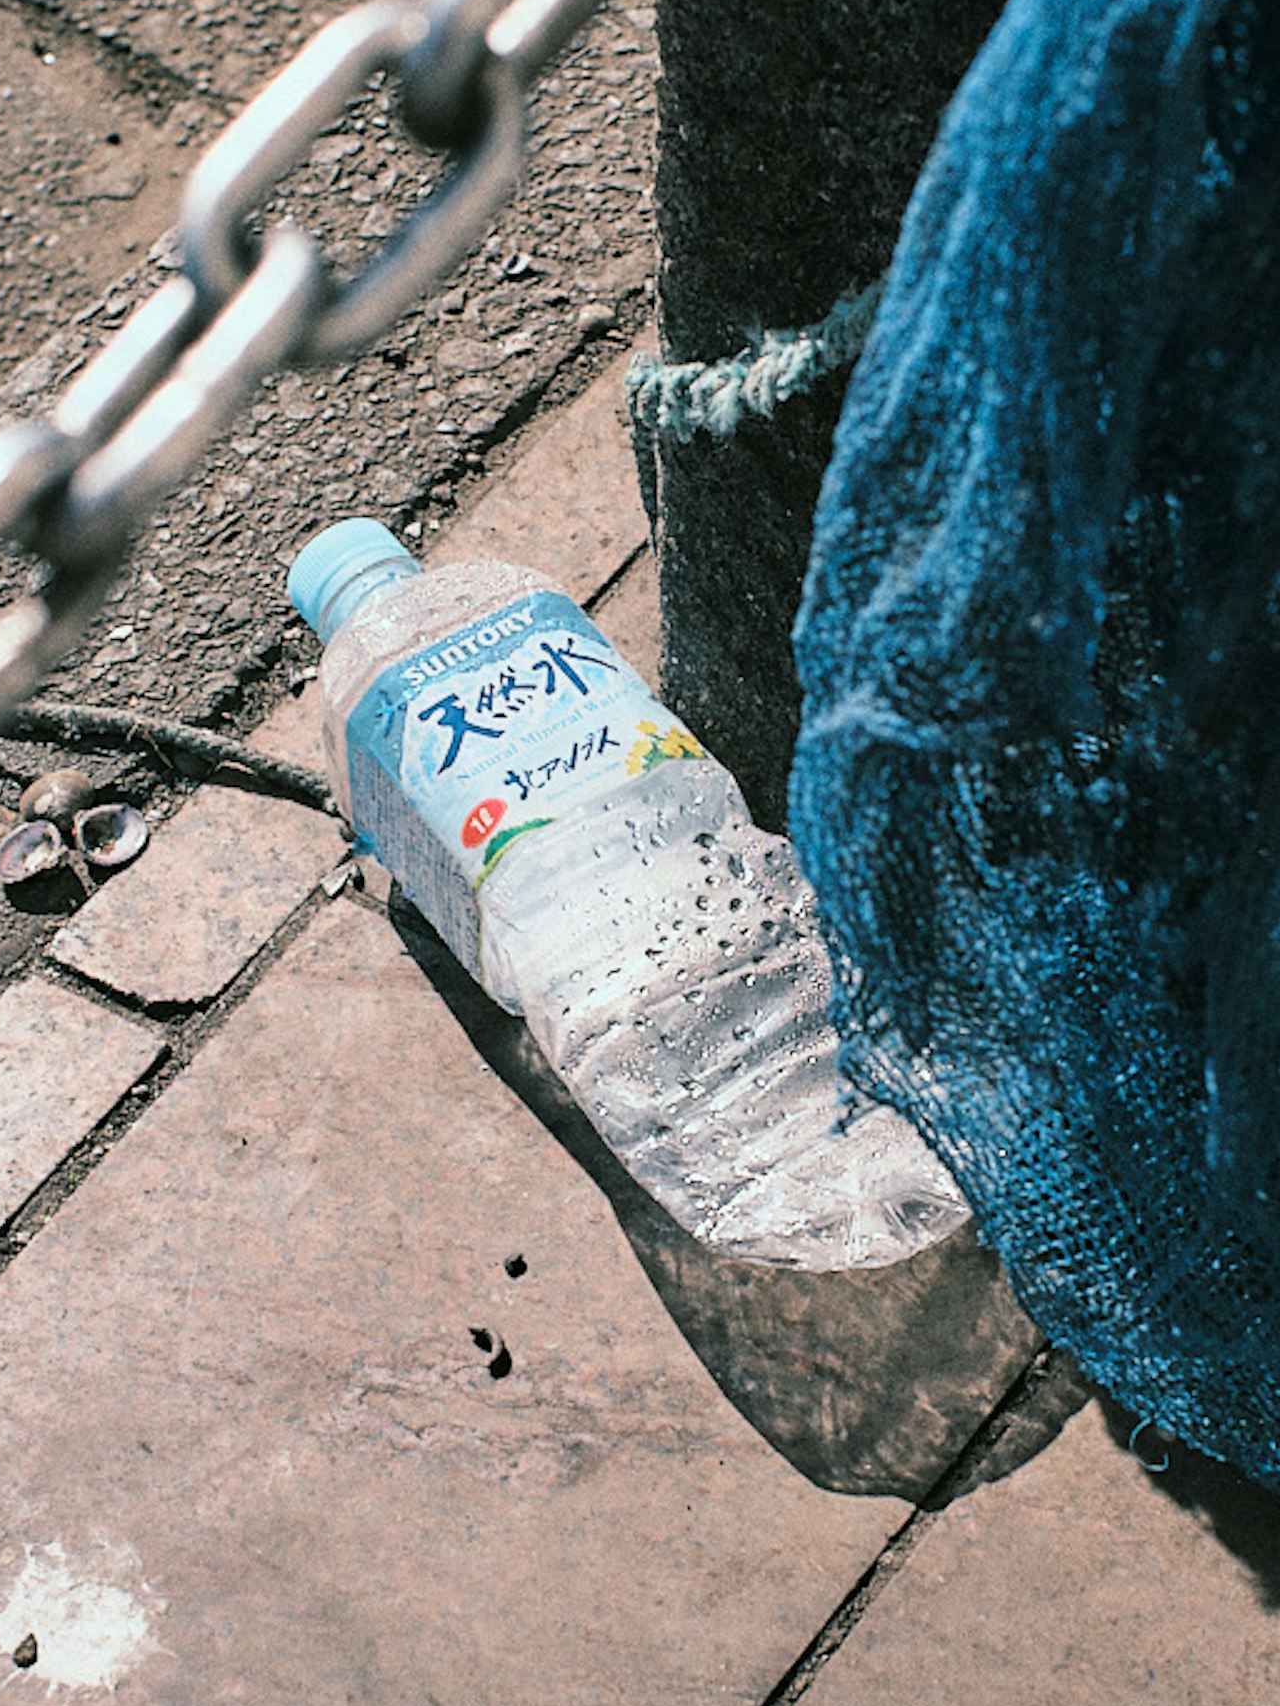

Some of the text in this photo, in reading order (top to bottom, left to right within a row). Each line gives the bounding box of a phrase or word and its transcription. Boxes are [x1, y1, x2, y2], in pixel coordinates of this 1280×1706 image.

[402, 607, 536, 687] SUNTORY
[417, 637, 619, 776] 天然水
[456, 743, 519, 779] Natural
[519, 707, 584, 745] Mineral
[503, 724, 621, 801] 北アルプス
